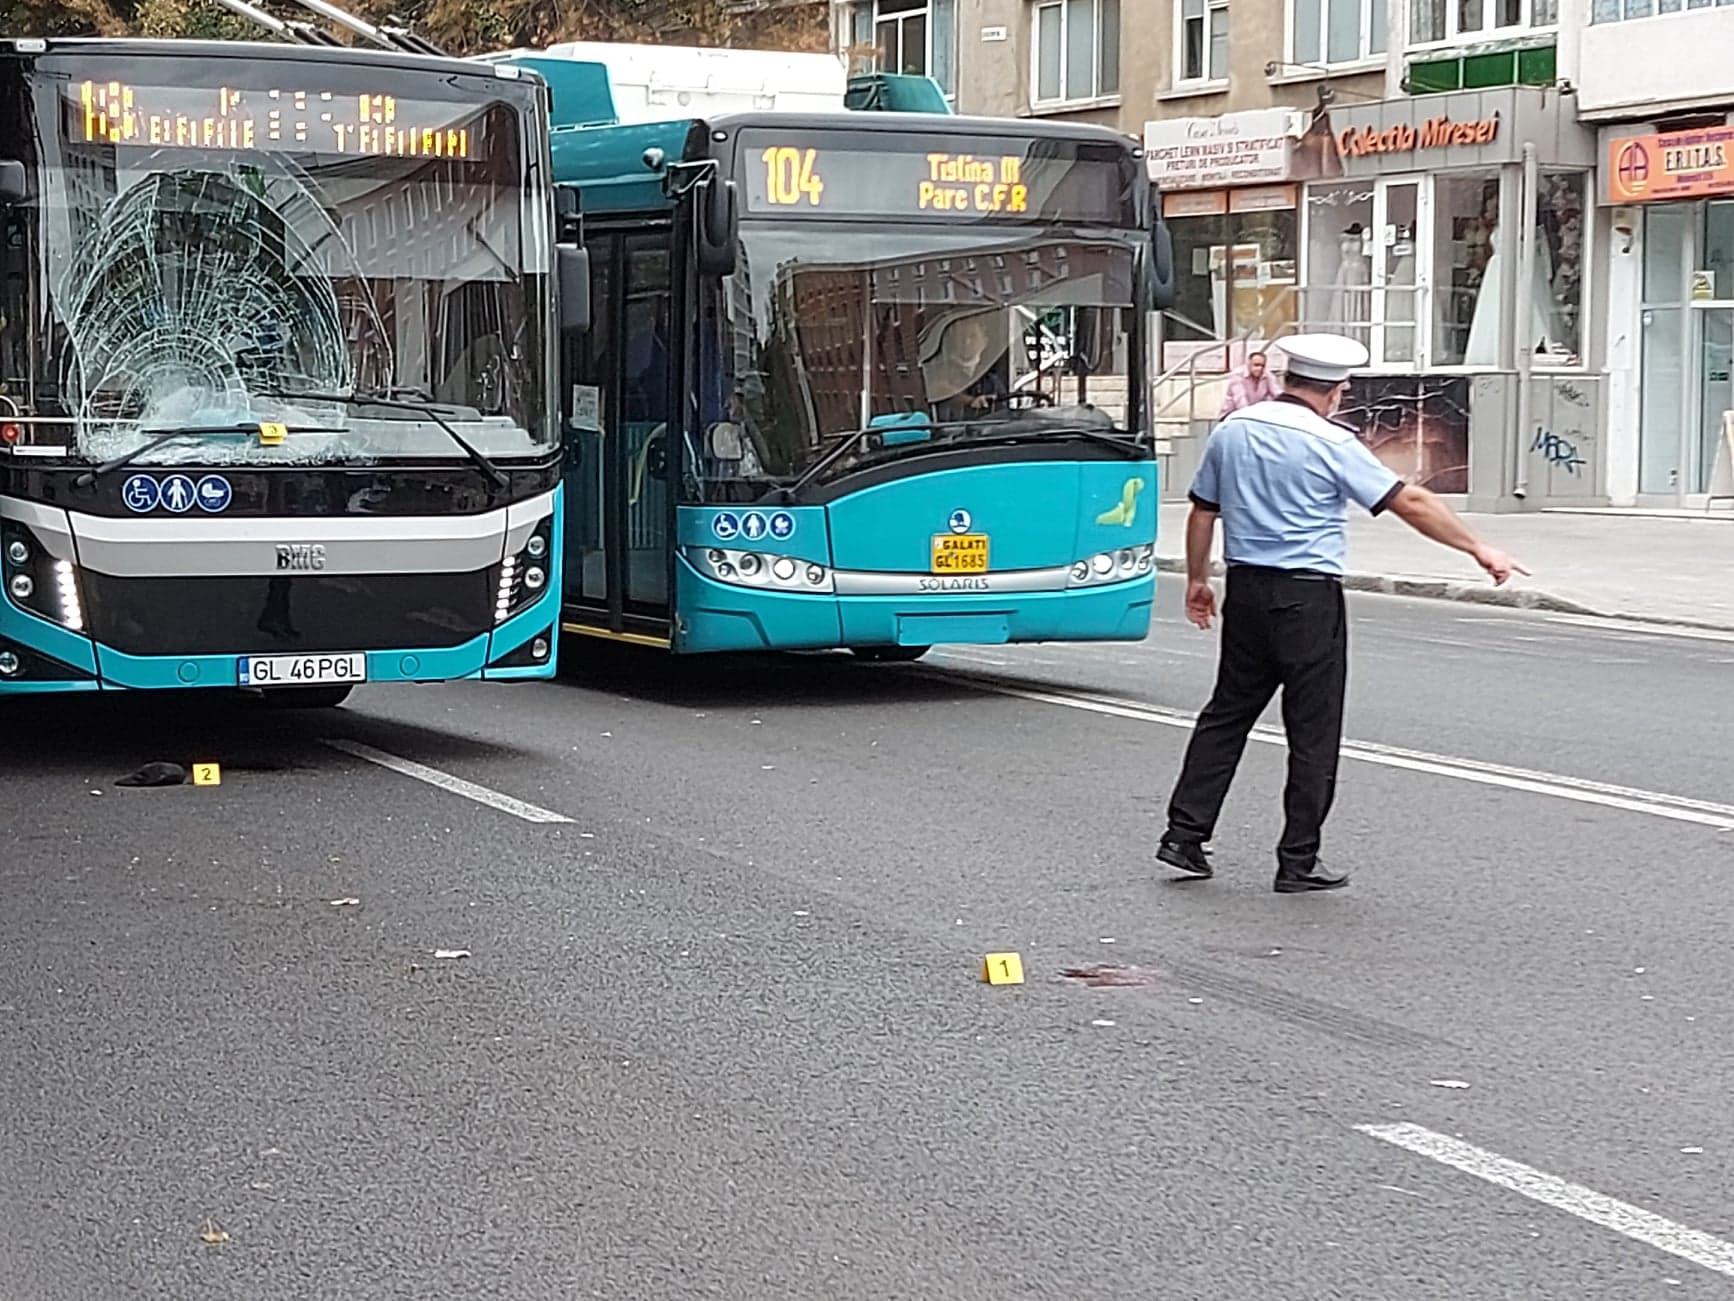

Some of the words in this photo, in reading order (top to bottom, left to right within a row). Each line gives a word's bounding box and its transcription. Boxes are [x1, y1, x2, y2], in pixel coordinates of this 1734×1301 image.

[1421, 109, 1500, 149] Miresei
[762, 147, 824, 206] 104
[918, 181, 968, 209] Parc
[918, 578, 990, 591] SOLARIS
[253, 660, 281, 681] GL
[201, 767, 212, 781] 2
[999, 959, 1009, 978] 1
